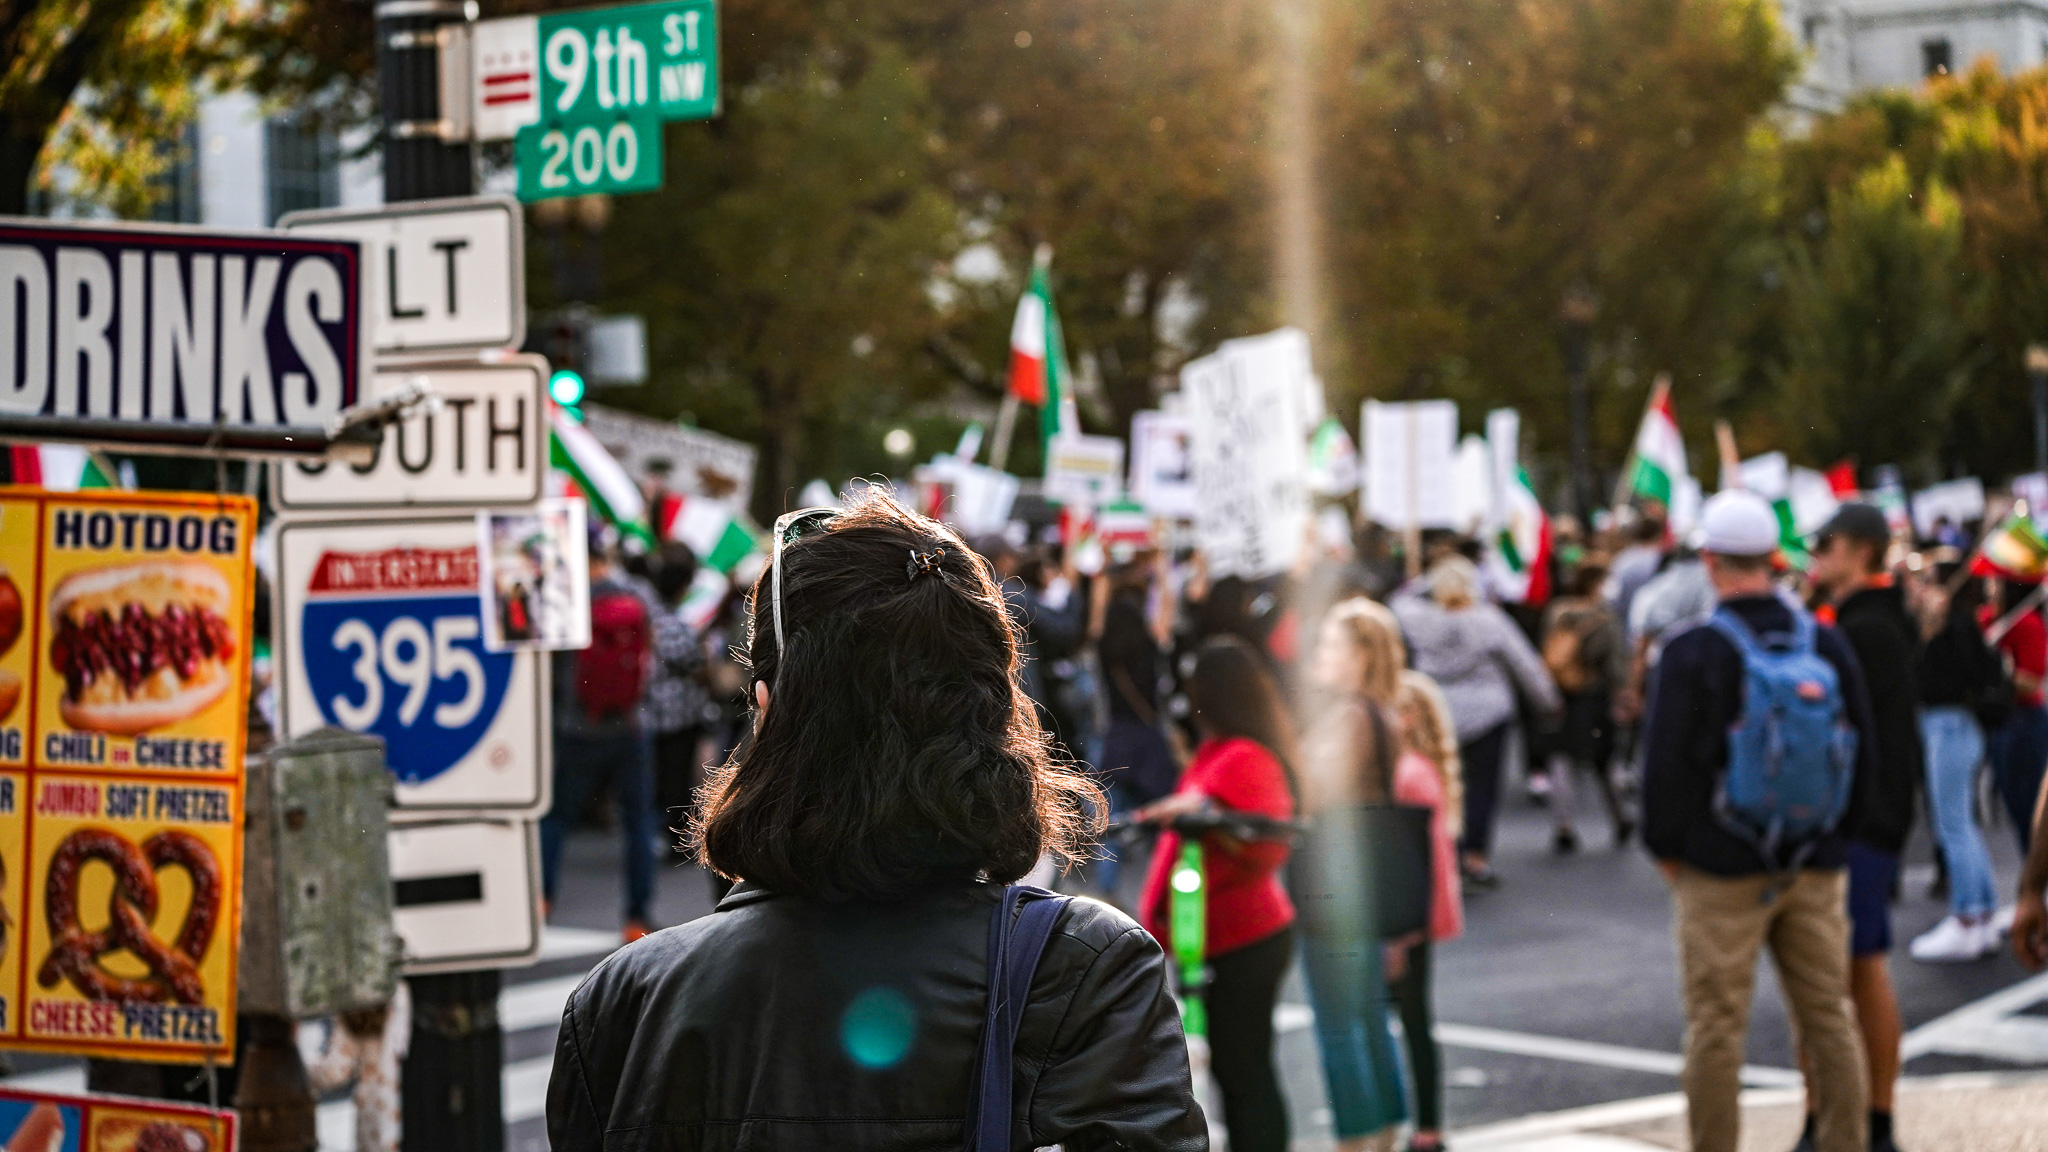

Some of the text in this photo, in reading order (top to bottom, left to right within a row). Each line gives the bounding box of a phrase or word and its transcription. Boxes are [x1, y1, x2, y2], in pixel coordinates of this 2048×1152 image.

[546, 11, 700, 113] 9th ST
[659, 61, 706, 103] NW
[540, 121, 638, 188] 200
[388, 238, 470, 319] LT
[0, 244, 344, 428] DRINKS
[55, 510, 236, 553] HOTDOG
[332, 616, 486, 730] 395
[46, 732, 105, 762] CHILI
[136, 735, 224, 769] CHEESE
[38, 783, 99, 815] JUMBO
[106, 784, 150, 819] SOFT
[155, 787, 231, 823] PRETZEL
[31, 1001, 116, 1035] CHEESE
[125, 1005, 222, 1043] PRETZEL
